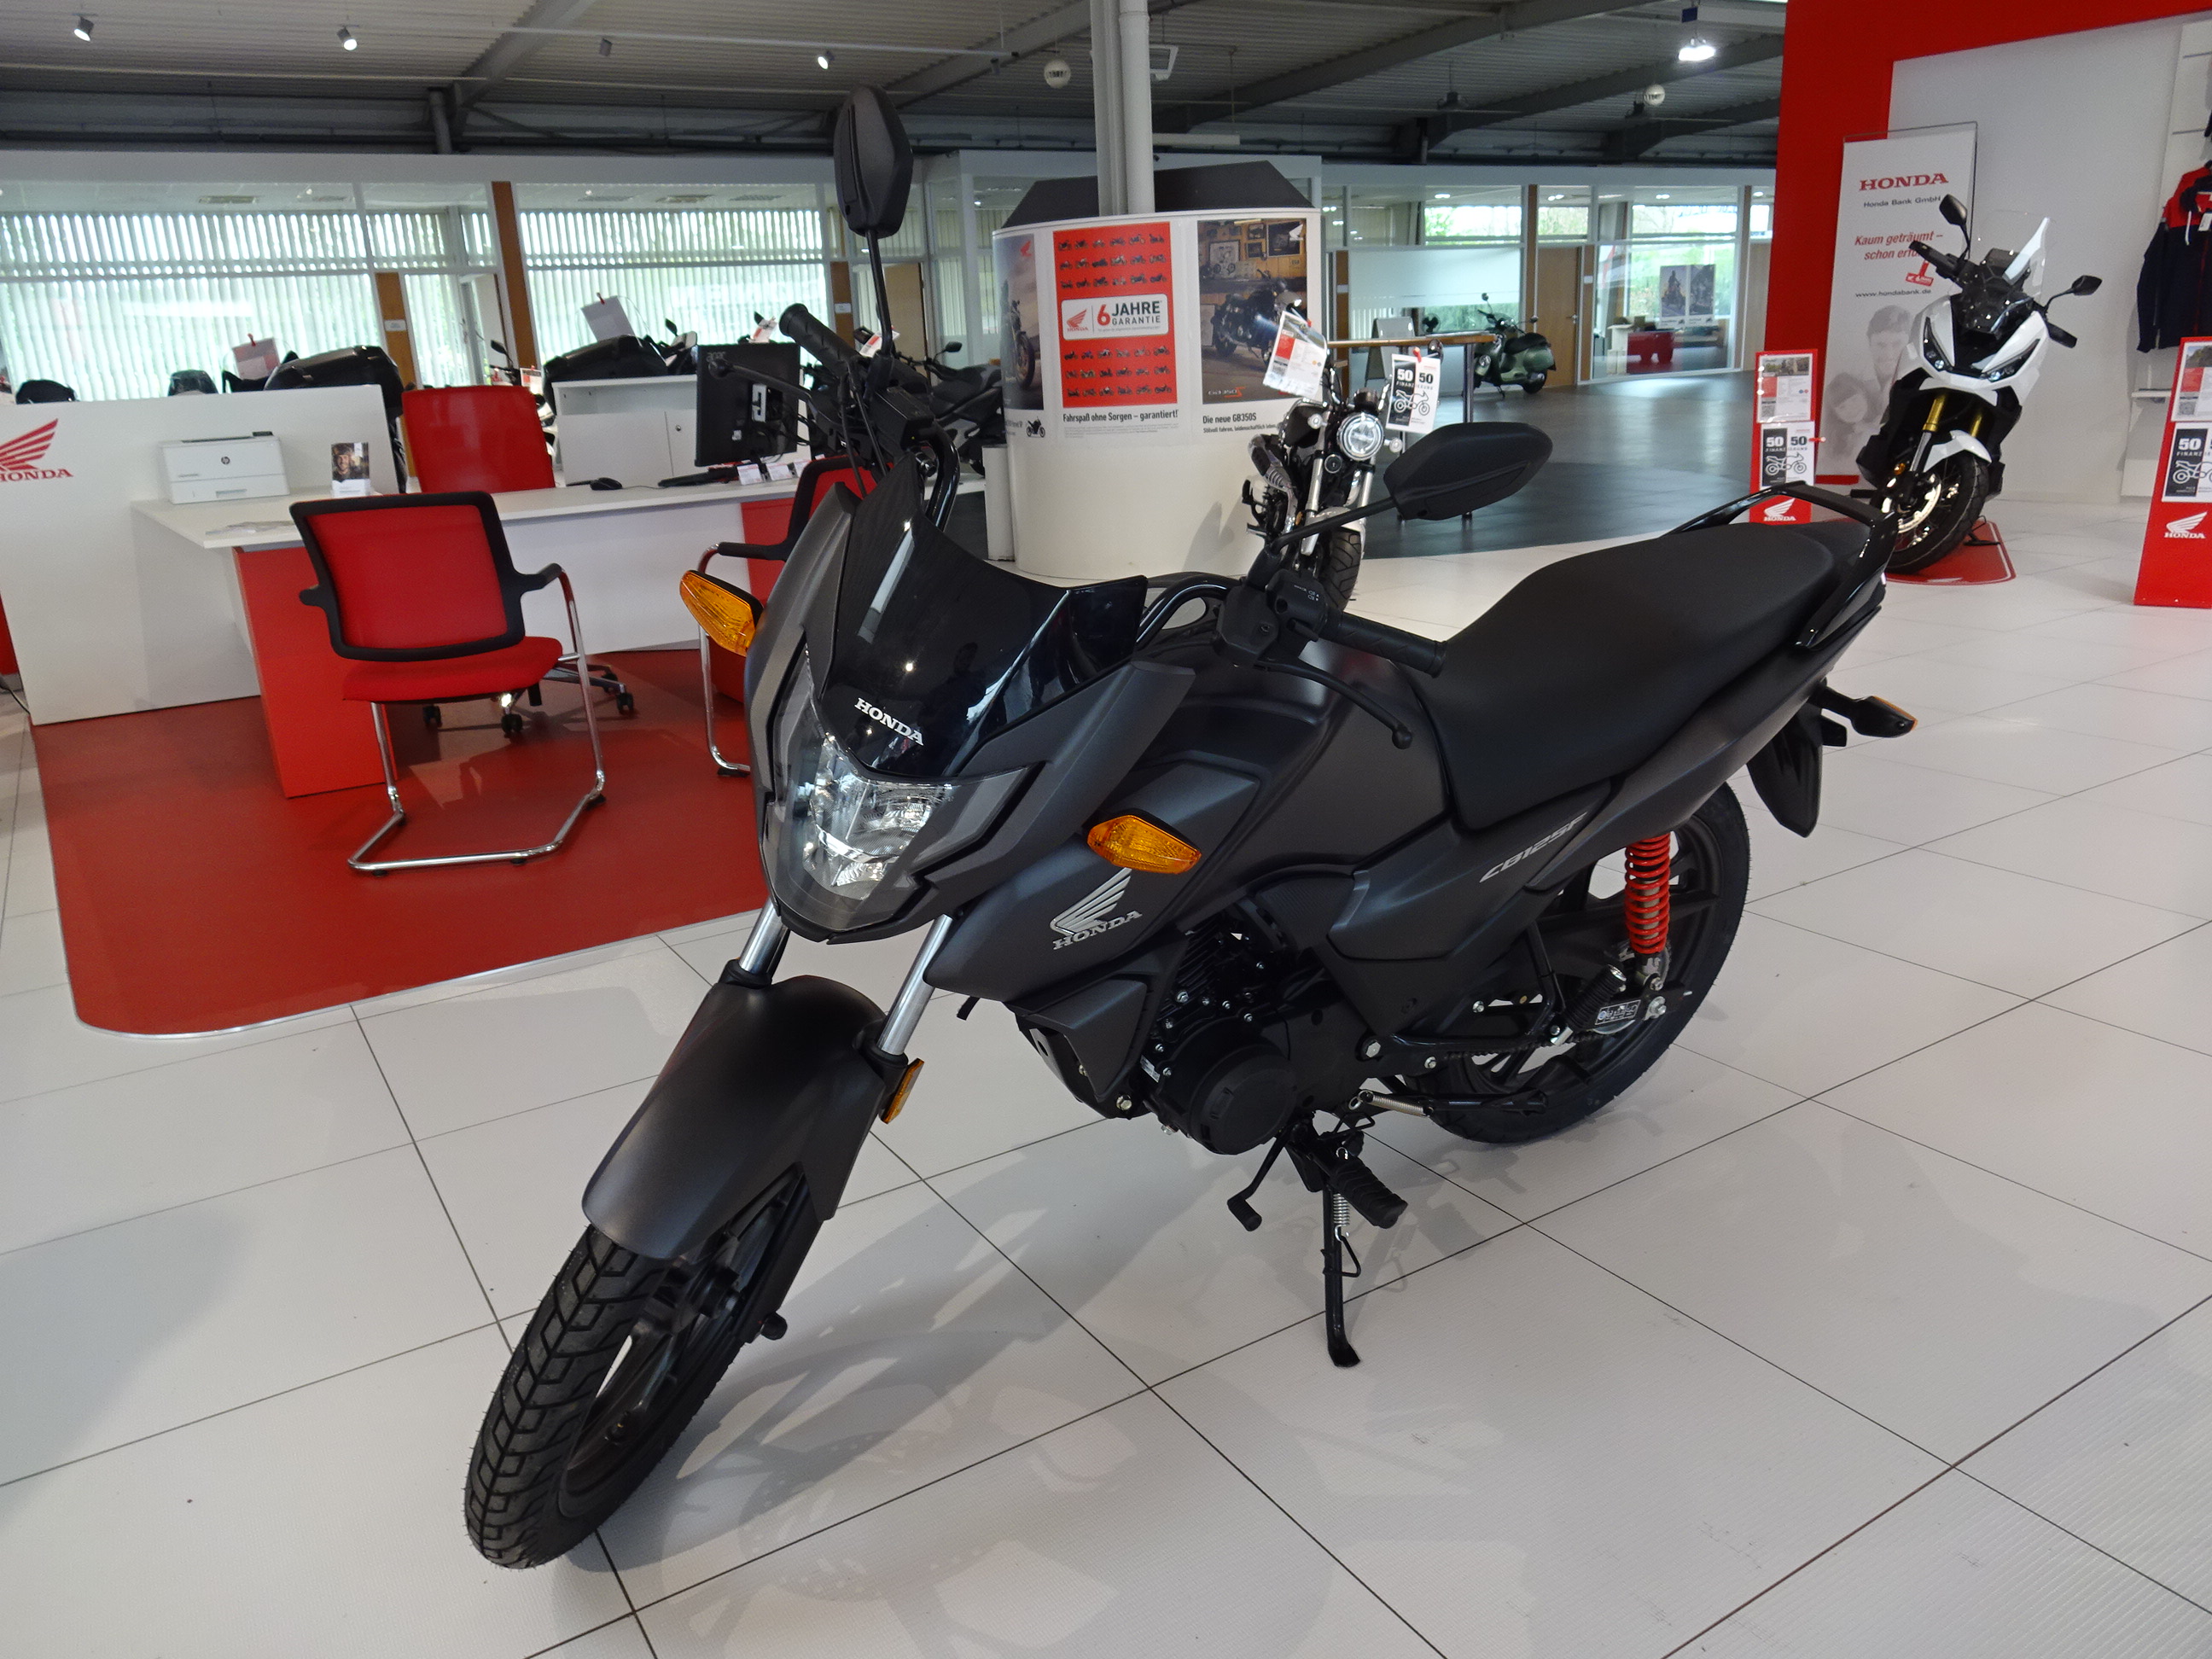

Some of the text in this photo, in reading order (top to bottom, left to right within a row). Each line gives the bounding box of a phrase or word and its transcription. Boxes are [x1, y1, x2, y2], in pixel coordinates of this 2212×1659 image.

[1859, 172, 1949, 192] HONDA
[1863, 200, 1889, 208] Honda
[1915, 195, 1941, 204] GmbH
[1854, 236, 1883, 246] Kaum
[1885, 230, 1935, 246] geträumt
[1864, 249, 1895, 260] schon
[1855, 288, 1932, 298] www.hondabank.de
[1097, 300, 1161, 326] 6 JAHRE
[1112, 315, 1161, 326] GARANTIE
[1397, 368, 1434, 384] 50 50
[1062, 412, 1090, 423] Fahrspaß
[1091, 413, 1107, 422] ohne
[1108, 412, 1132, 422] Sorgen
[1202, 415, 1214, 424] Die
[1232, 412, 1257, 422] GB350S
[1766, 435, 1807, 447] 50 50
[2178, 438, 2202, 451] 50
[853, 697, 924, 746] HONDA
[1479, 811, 1588, 883] CB125F
[1052, 910, 1143, 951] HONDA
